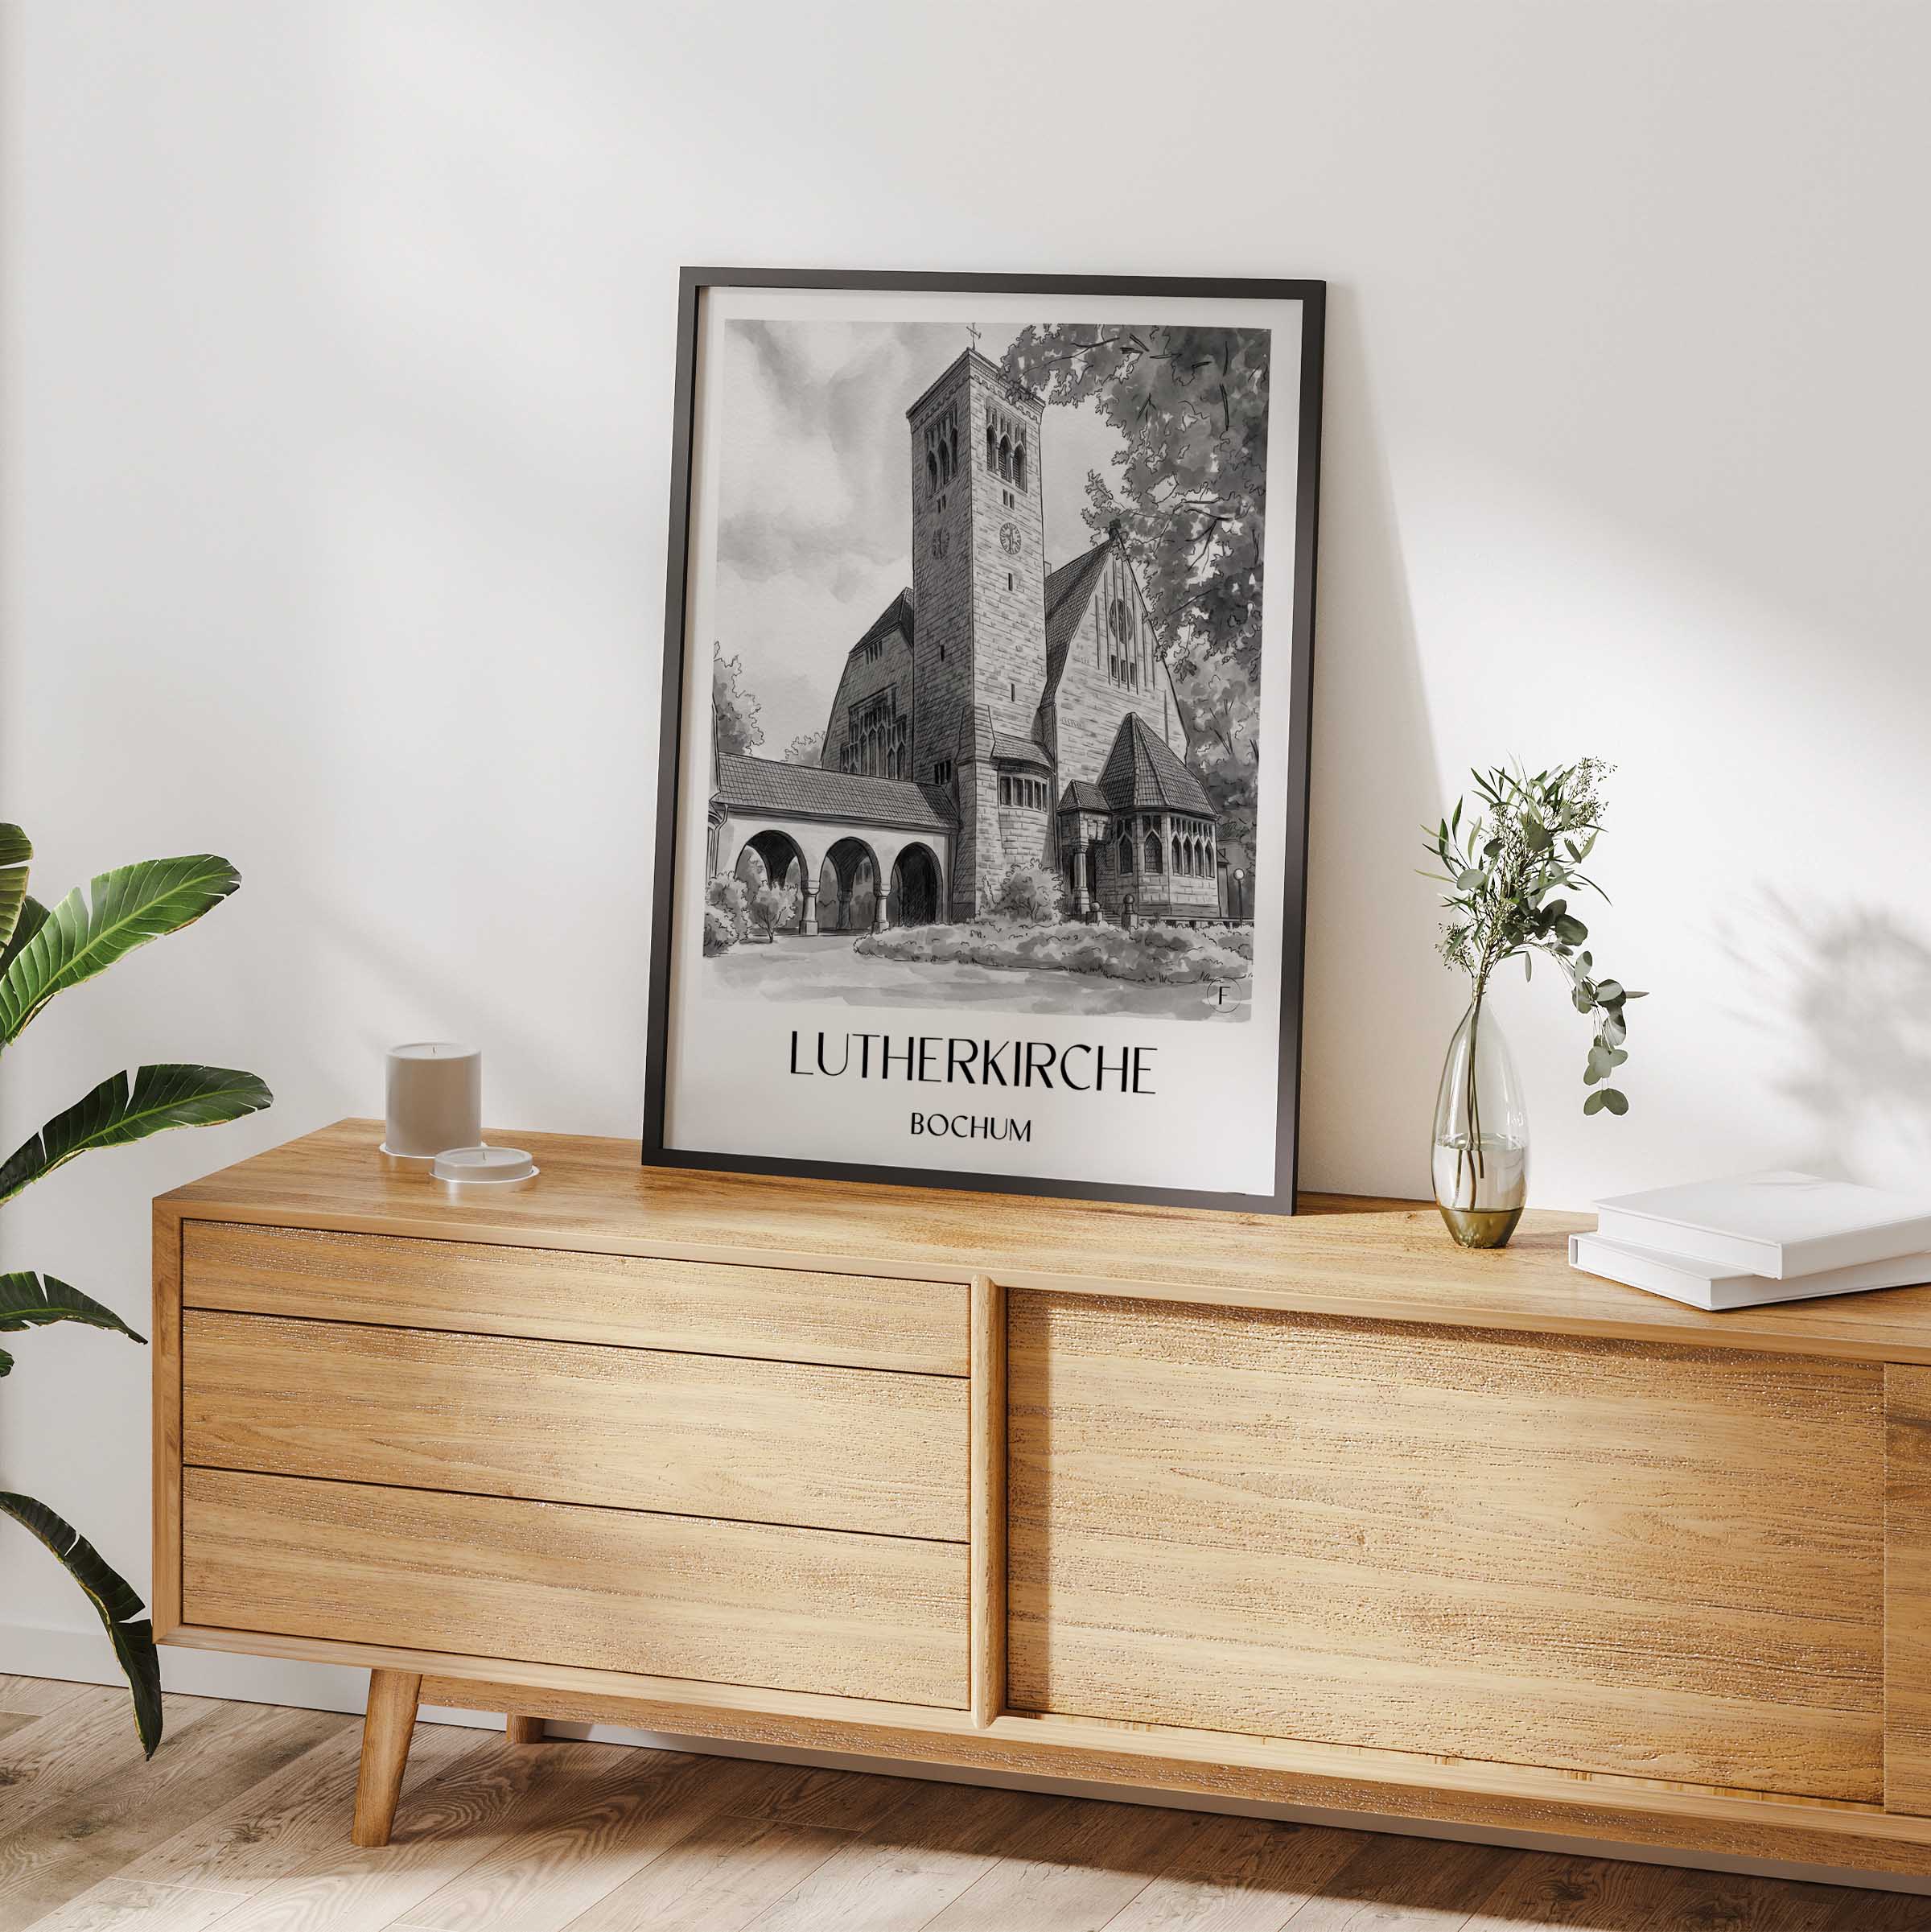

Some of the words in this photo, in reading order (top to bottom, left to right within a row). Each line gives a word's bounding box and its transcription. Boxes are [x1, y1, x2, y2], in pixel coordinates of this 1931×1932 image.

[1218, 986, 1231, 1005] F
[790, 1030, 1159, 1094] LUTHERKIRCHE
[910, 1112, 1031, 1143] BOCHUM
